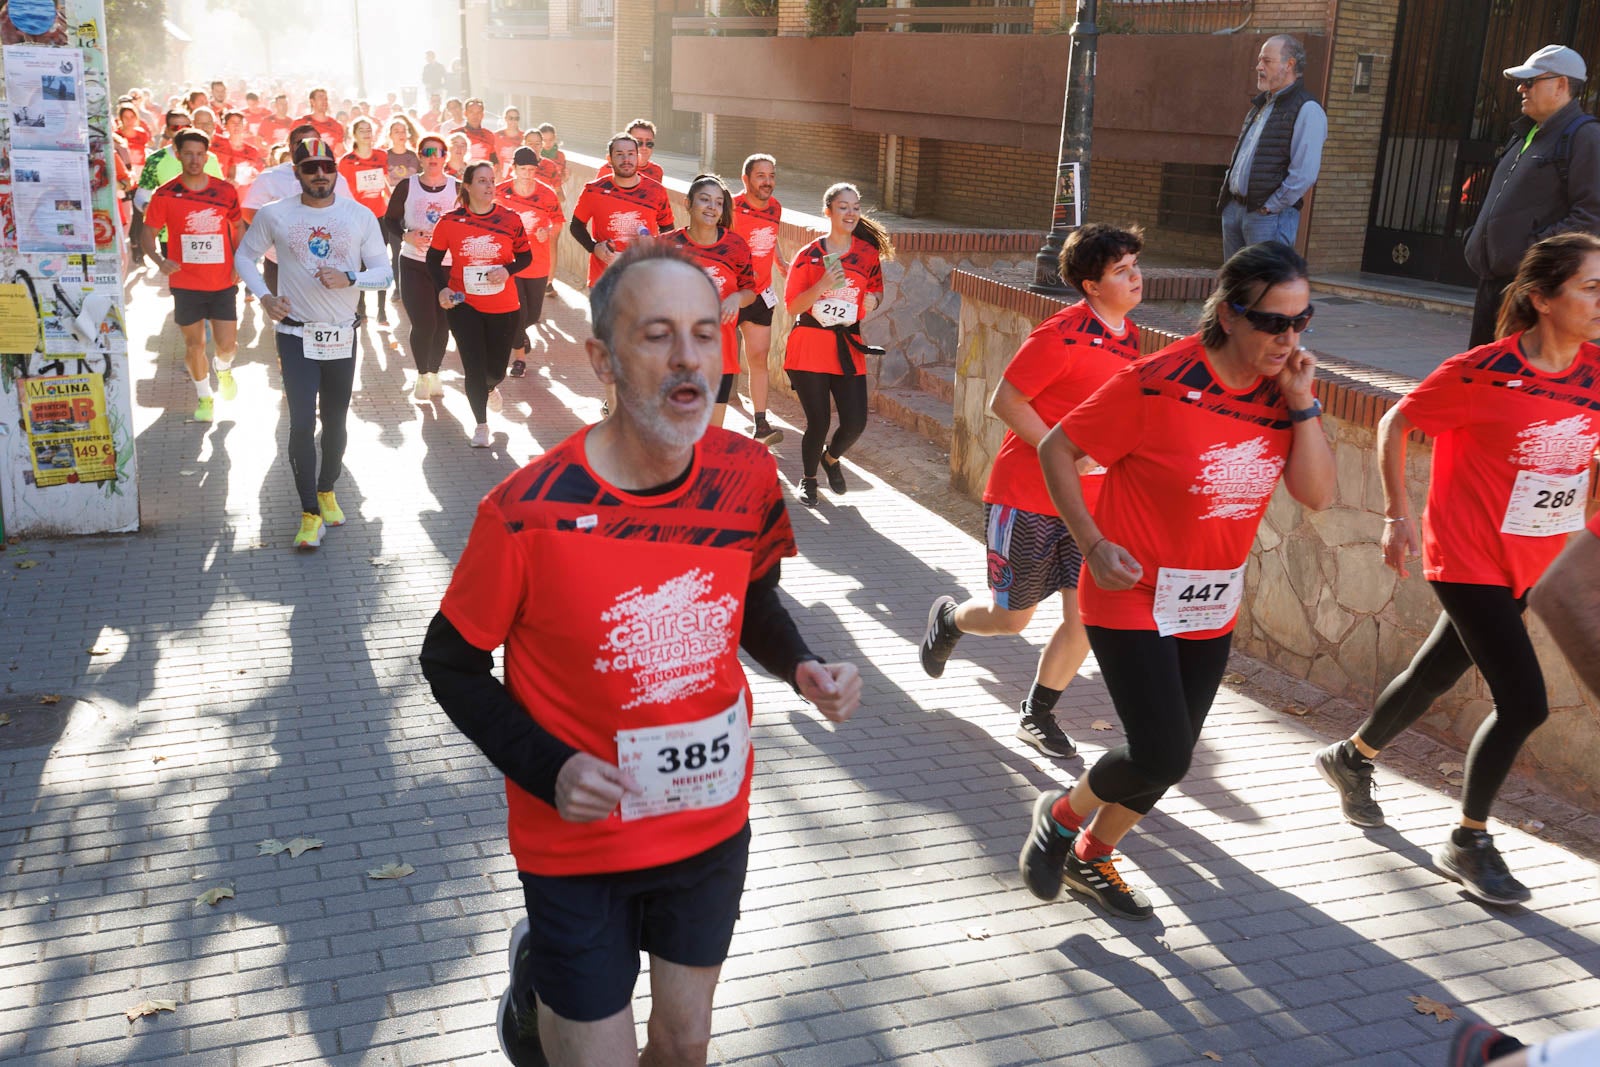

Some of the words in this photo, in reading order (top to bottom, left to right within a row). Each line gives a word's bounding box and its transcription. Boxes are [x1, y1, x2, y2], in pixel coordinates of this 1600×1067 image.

[191, 241, 212, 250] 876
[823, 304, 846, 318] 212
[315, 331, 339, 342] 871
[31, 382, 90, 396] MOLINA
[75, 445, 98, 458] 149
[1520, 438, 1593, 454] carrera
[1203, 463, 1277, 480] carrera
[1533, 488, 1577, 509] 288
[1178, 583, 1230, 602] 447
[609, 605, 728, 649] carrera
[656, 732, 731, 774] 385
